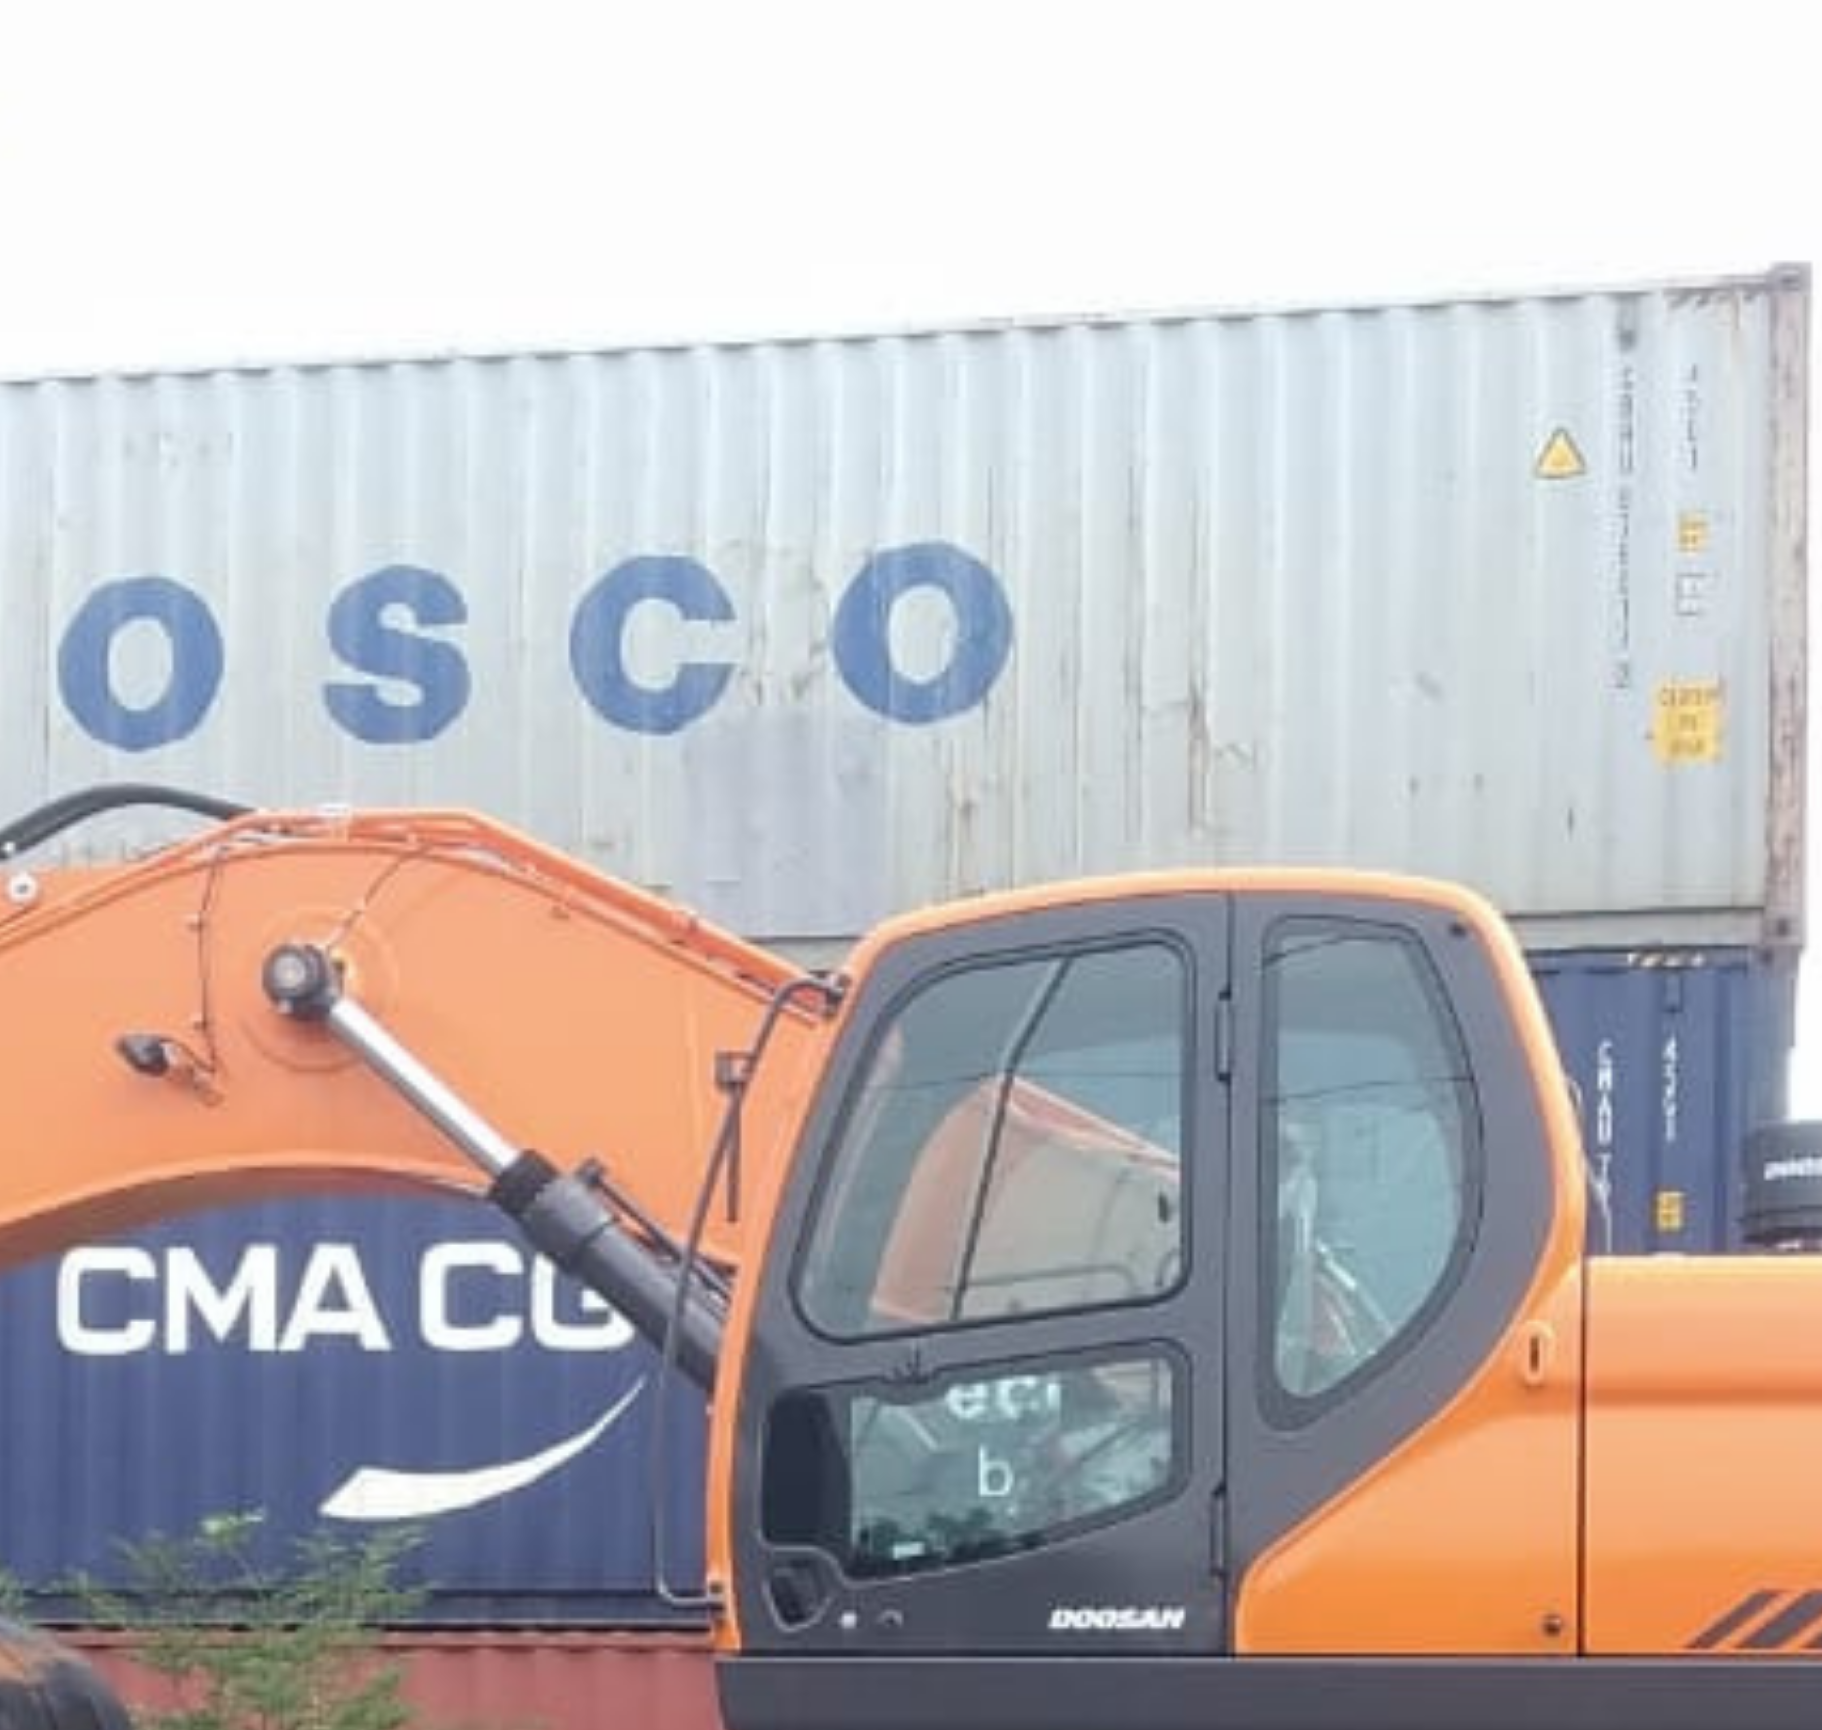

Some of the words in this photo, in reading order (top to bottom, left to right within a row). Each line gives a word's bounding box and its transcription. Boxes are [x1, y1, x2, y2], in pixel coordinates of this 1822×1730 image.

[57, 1241, 392, 1355] CMA
[419, 1240, 636, 1352] CG
[1048, 1608, 1185, 1629] DOOSAN
